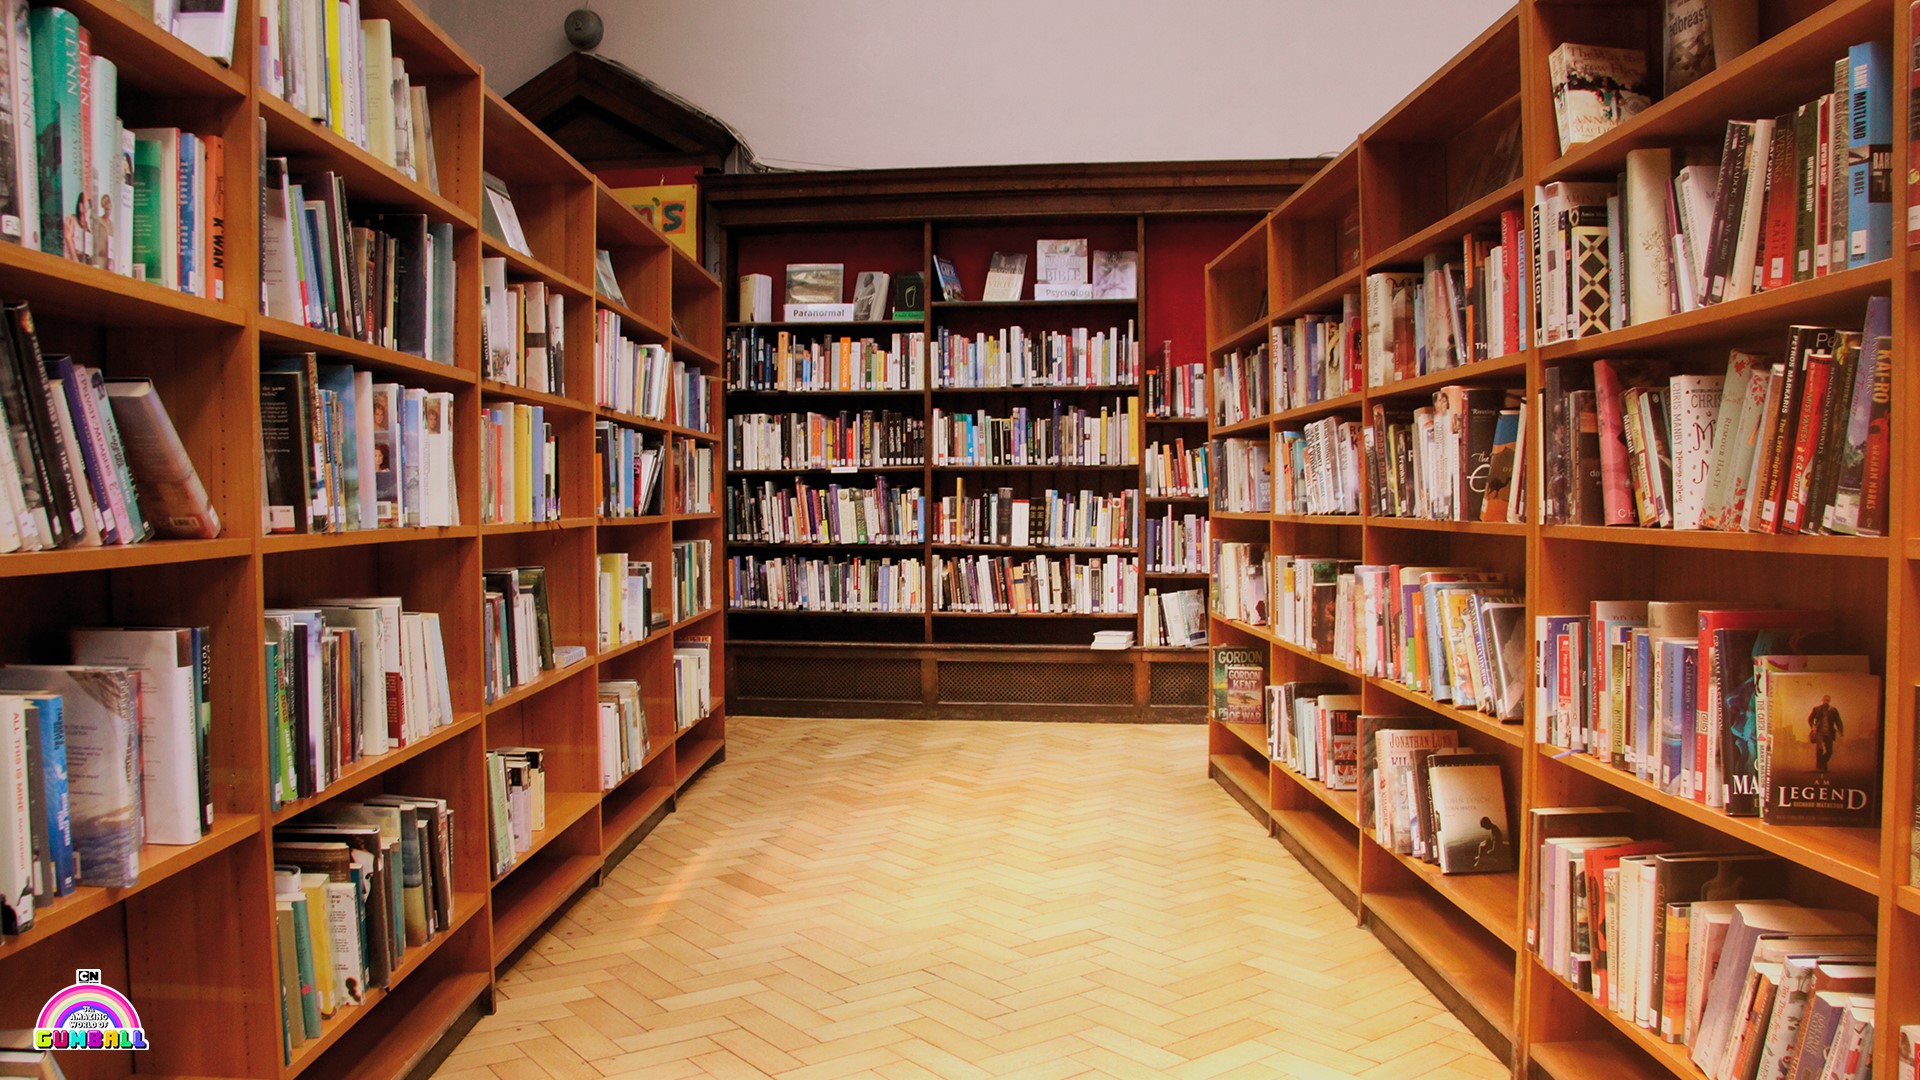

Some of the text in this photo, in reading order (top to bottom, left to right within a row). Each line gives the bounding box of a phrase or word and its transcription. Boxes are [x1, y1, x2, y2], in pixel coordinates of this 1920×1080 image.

[64, 26, 79, 97] FLYNN
[79, 38, 91, 107] FLYNN
[1853, 91, 1867, 141] MAITLAND
[1805, 155, 1815, 213] norman mailer
[1854, 170, 1864, 197] BABEL
[212, 216, 225, 269] K'WAN
[1532, 210, 1543, 305] Adult Fiction
[1045, 270, 1081, 282] BIBLE
[793, 309, 845, 318] Paranormal
[1672, 382, 1683, 446] CHRIS MANBY
[1771, 334, 1799, 478] PETROS MARKARIS The Late-night
[1803, 392, 1814, 417] MISS
[106, 417, 115, 433] THE
[1622, 414, 1635, 454] Mankell
[60, 450, 70, 471] THE
[1398, 454, 1407, 485] Frankie
[1869, 444, 1880, 482] GRAHAM
[1866, 483, 1877, 511] MARKS
[1217, 650, 1263, 664] GORDON
[1712, 634, 1724, 675] GRAHAM
[277, 667, 286, 692] MAD
[1228, 670, 1261, 680] GORDON
[1232, 680, 1257, 690] KENT
[280, 693, 289, 723] DOGS
[1757, 699, 1767, 712] THE
[13, 712, 22, 735] ALL
[1757, 712, 1767, 730] CATCH
[14, 739, 22, 765] THIS
[1389, 732, 1430, 749] JONATHAN
[1759, 744, 1768, 764] MARK
[15, 767, 22, 779] IS
[16, 782, 25, 813] MINE
[1778, 784, 1868, 810] LEGEND
